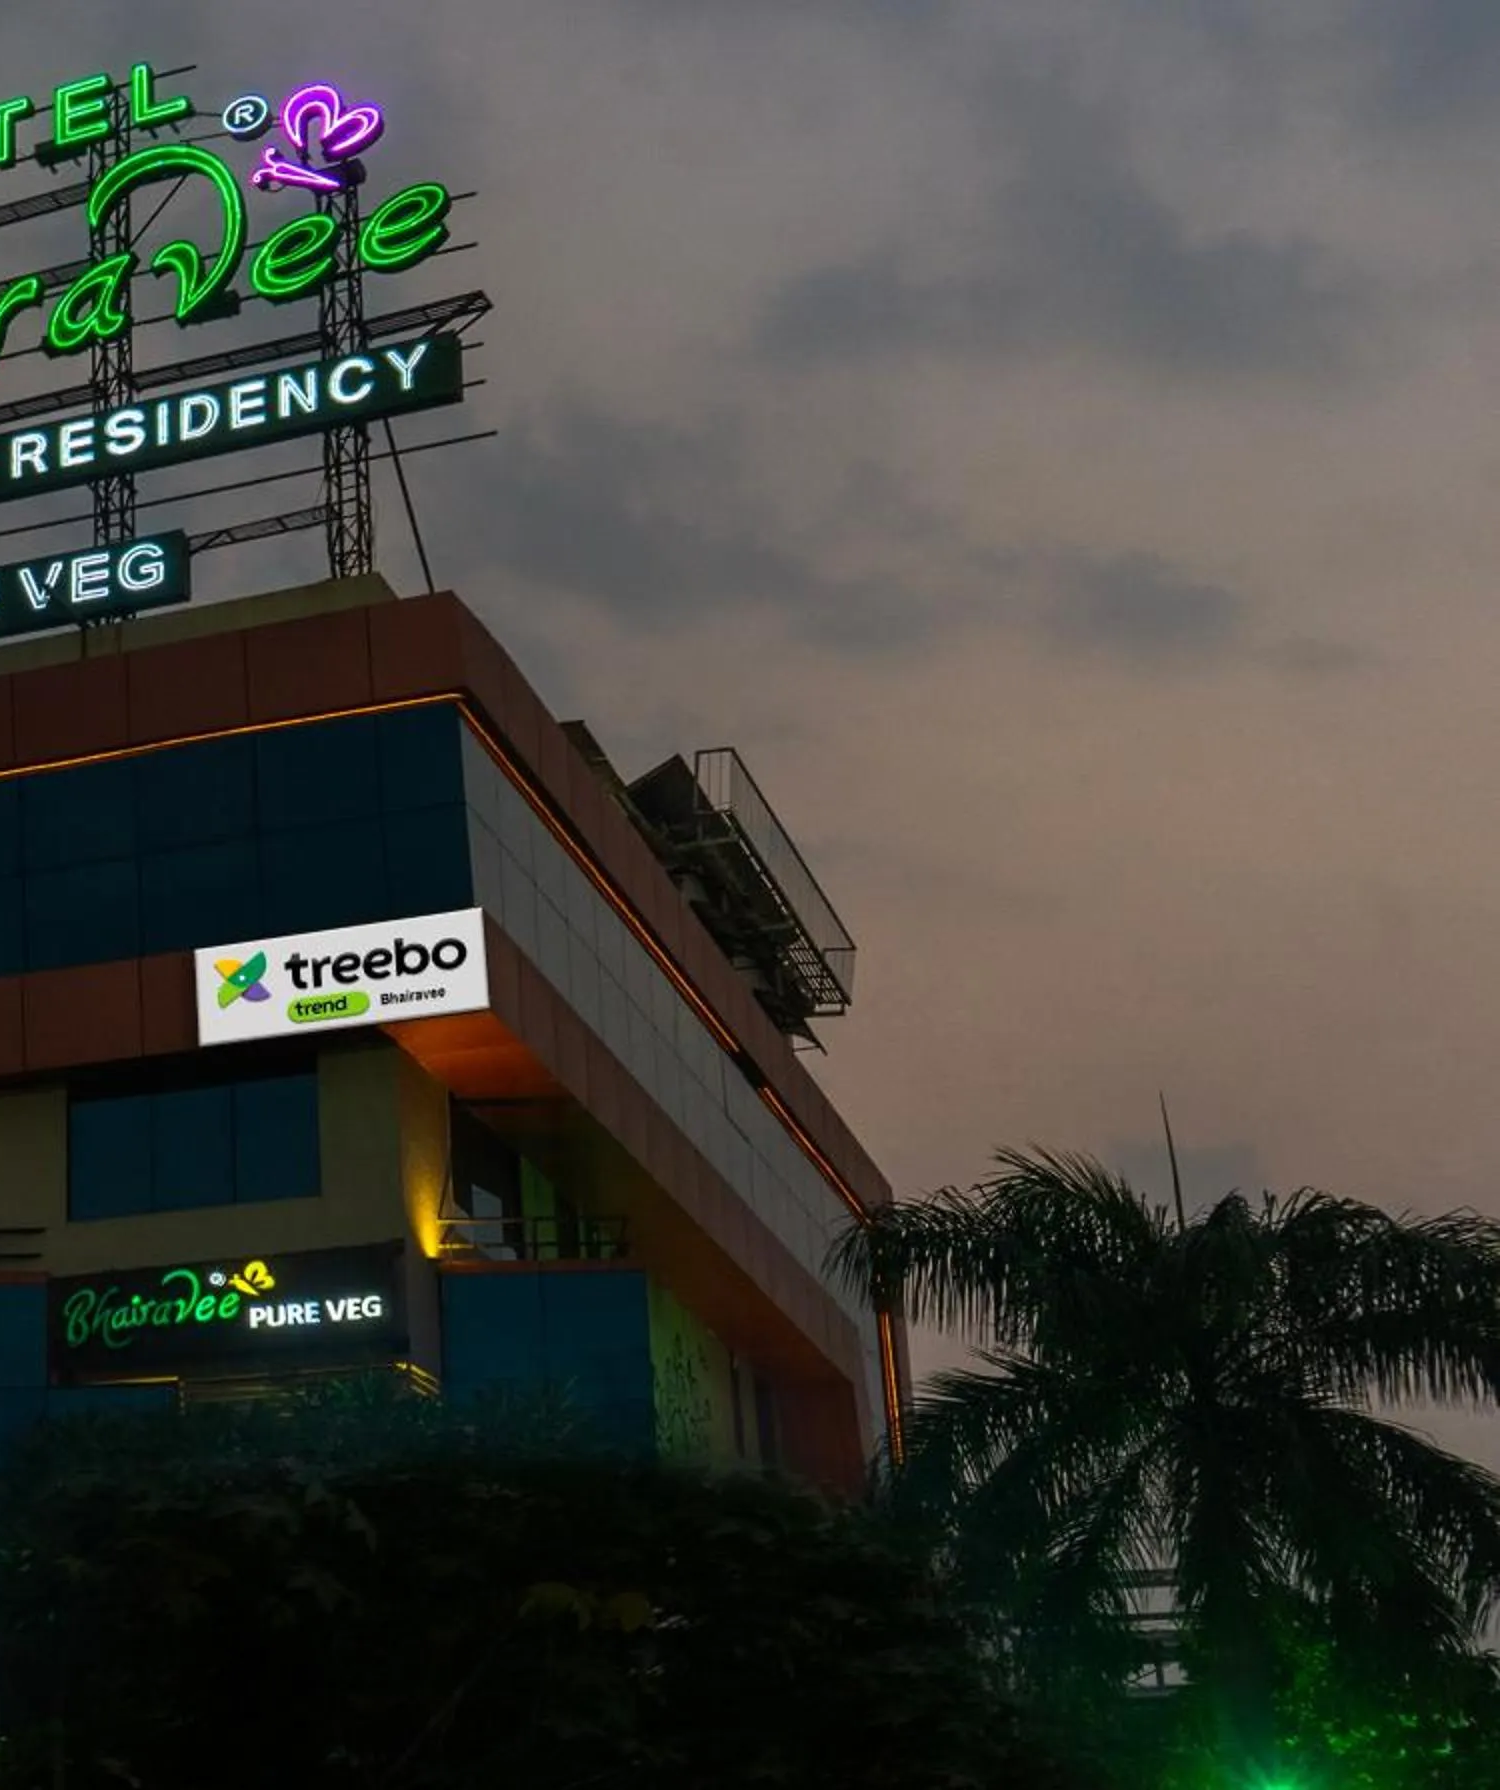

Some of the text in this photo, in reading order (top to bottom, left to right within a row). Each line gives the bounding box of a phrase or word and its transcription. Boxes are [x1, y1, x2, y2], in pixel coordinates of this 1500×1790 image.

[10, 344, 429, 479] RESIDENCY
[19, 541, 167, 612] VEG
[284, 937, 467, 990] treebo
[295, 986, 446, 1017] trend Bhairavee
[248, 1301, 321, 1329] PURE
[325, 1295, 382, 1322] VEG
